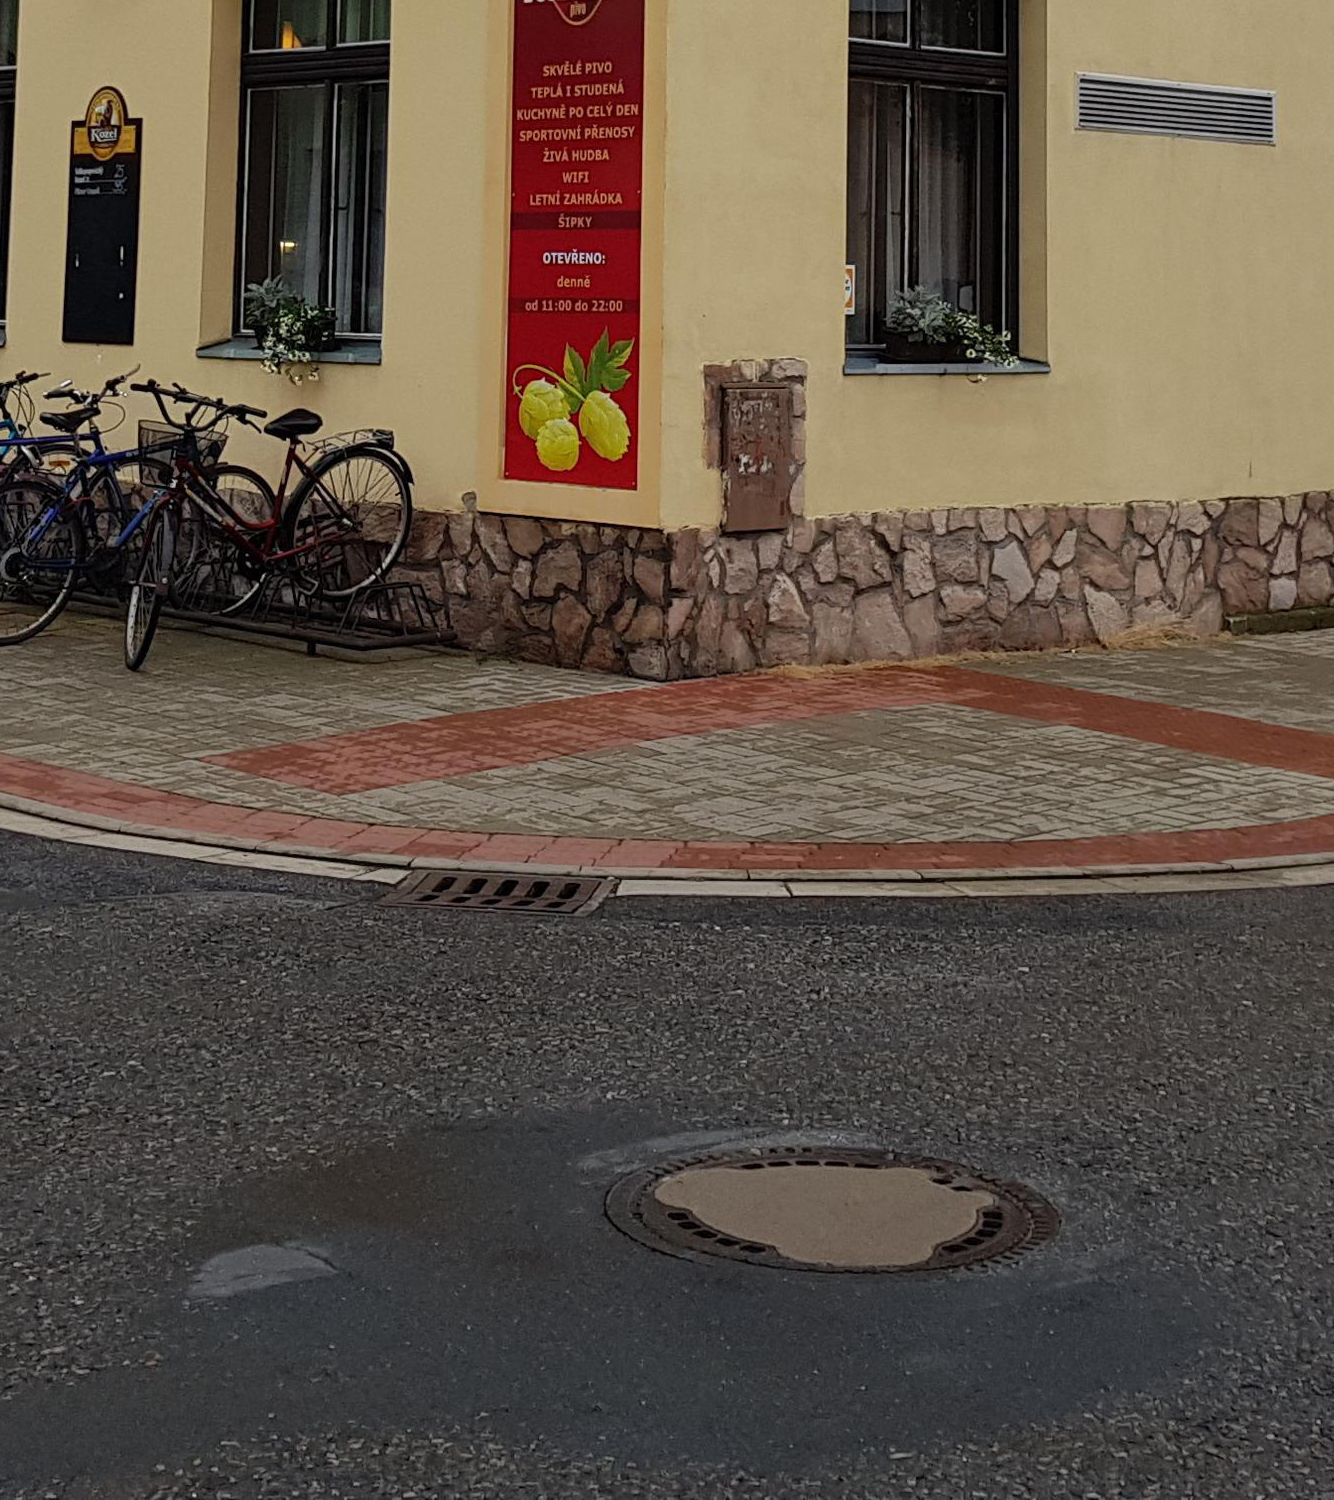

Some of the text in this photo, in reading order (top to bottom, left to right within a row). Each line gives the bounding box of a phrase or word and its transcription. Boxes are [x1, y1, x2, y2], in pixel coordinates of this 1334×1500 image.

[542, 60, 612, 77] SKVĚLÉ PIVO
[531, 79, 625, 99] TEPLÁ I STUDENÁ
[516, 101, 639, 121] KUCHYNĚ PO CELÝ DEN
[90, 127, 118, 143] Kozel
[519, 124, 636, 142] SPORTOVNÍ PŘENOSY
[543, 147, 610, 163] ŽIVÁ HUDBA
[562, 171, 589, 184] WIFI
[529, 189, 623, 206] LETNÍ ZAHRÁDKA
[558, 213, 593, 228] ŠIPKY
[542, 248, 606, 265] OTEVŘENO:
[556, 275, 591, 288] denně
[525, 299, 623, 312] od 11:00 do 22:00
